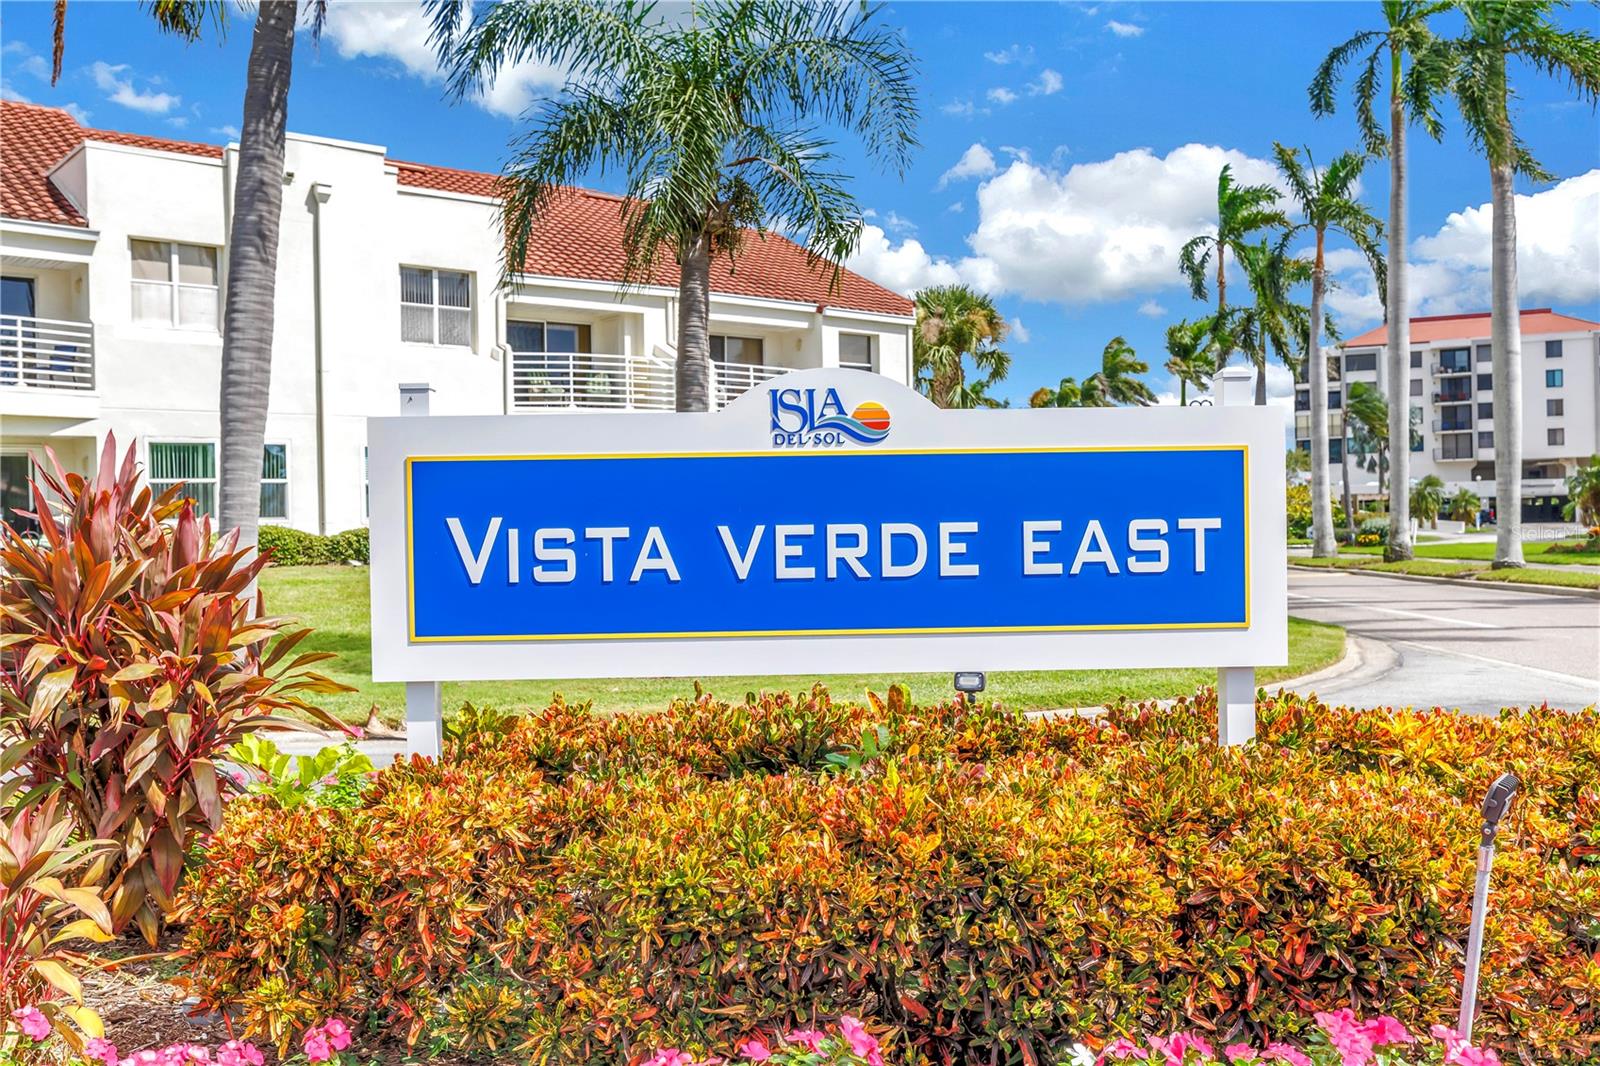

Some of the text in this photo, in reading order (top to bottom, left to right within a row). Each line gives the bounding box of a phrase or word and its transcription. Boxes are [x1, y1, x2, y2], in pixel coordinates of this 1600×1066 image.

[769, 388, 848, 433] ISLA
[813, 432, 845, 446] SOL
[446, 516, 1222, 584] VISTA VERDE EAST
